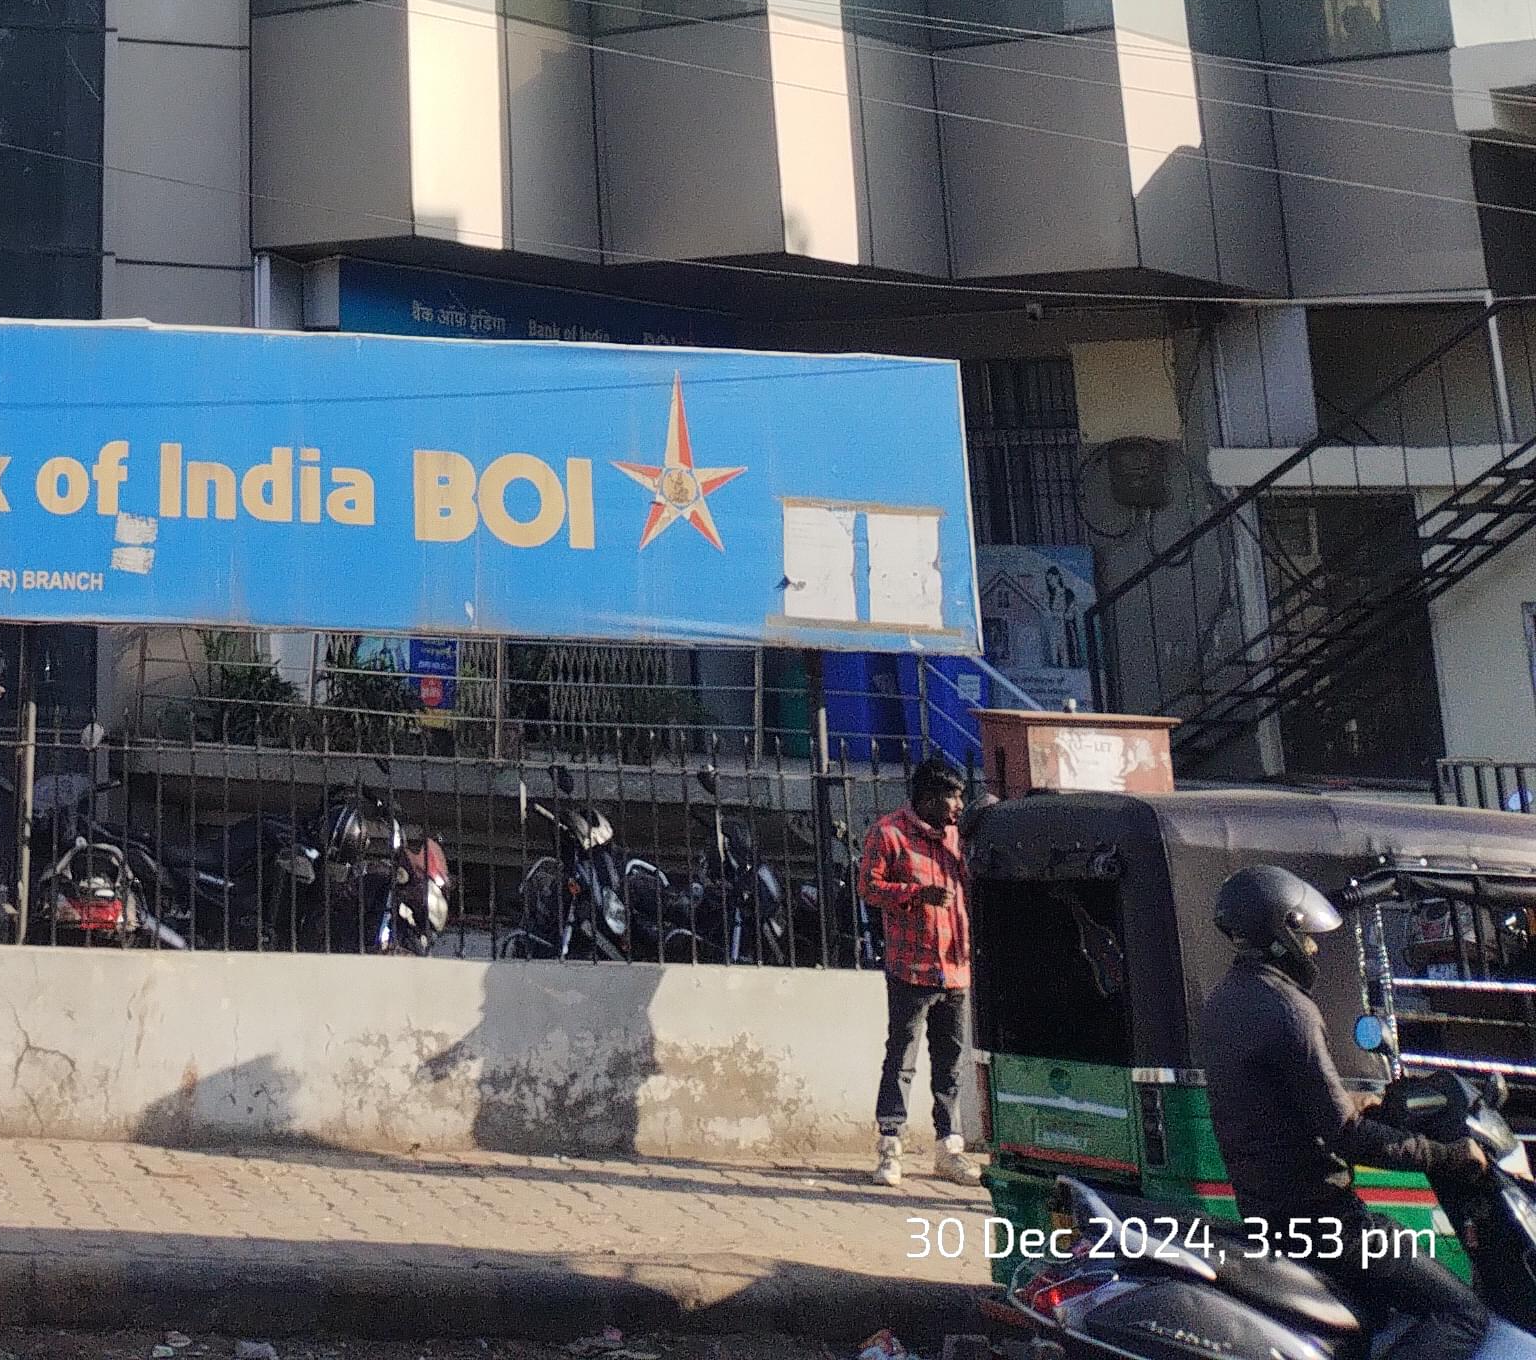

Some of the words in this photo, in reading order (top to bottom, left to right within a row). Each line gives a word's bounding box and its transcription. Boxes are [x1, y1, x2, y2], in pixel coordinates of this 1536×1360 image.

[36, 440, 130, 516] of
[158, 442, 375, 526] India
[413, 450, 595, 549] BOI
[22, 571, 104, 591] BRANCH
